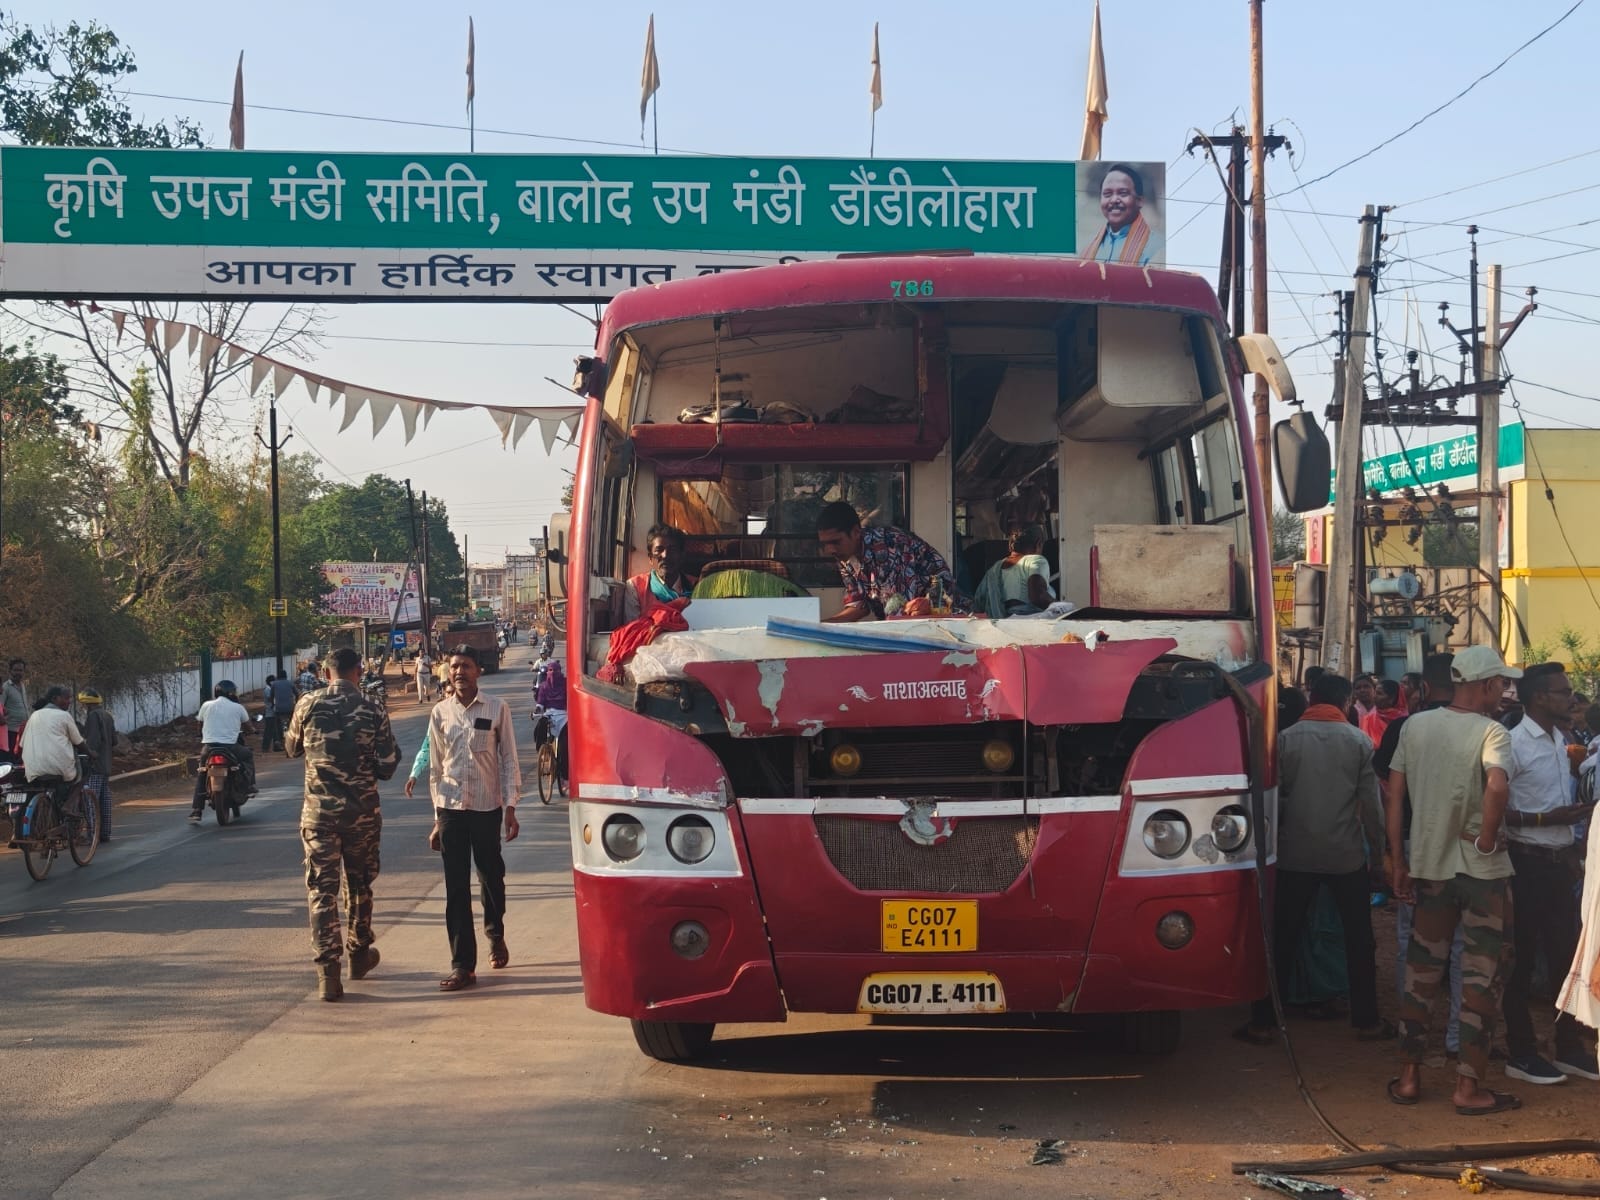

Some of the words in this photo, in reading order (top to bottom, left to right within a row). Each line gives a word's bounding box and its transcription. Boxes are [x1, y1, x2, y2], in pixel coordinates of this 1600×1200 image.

[44, 157, 127, 238] कृषि
[149, 175, 252, 221] उपज
[269, 160, 346, 223] मंडी
[365, 162, 501, 235] समिति,
[515, 161, 633, 226] बालोद
[652, 180, 710, 226] उप
[733, 165, 805, 226] मंडी
[829, 165, 1037, 234] डौंडीलोहारा
[206, 260, 356, 288] आपका
[378, 253, 516, 288] हार्दिक
[535, 263, 676, 289] स्वागत
[890, 280, 933, 296] 786
[908, 907, 957, 926] CG07
[901, 929, 961, 946] E4111
